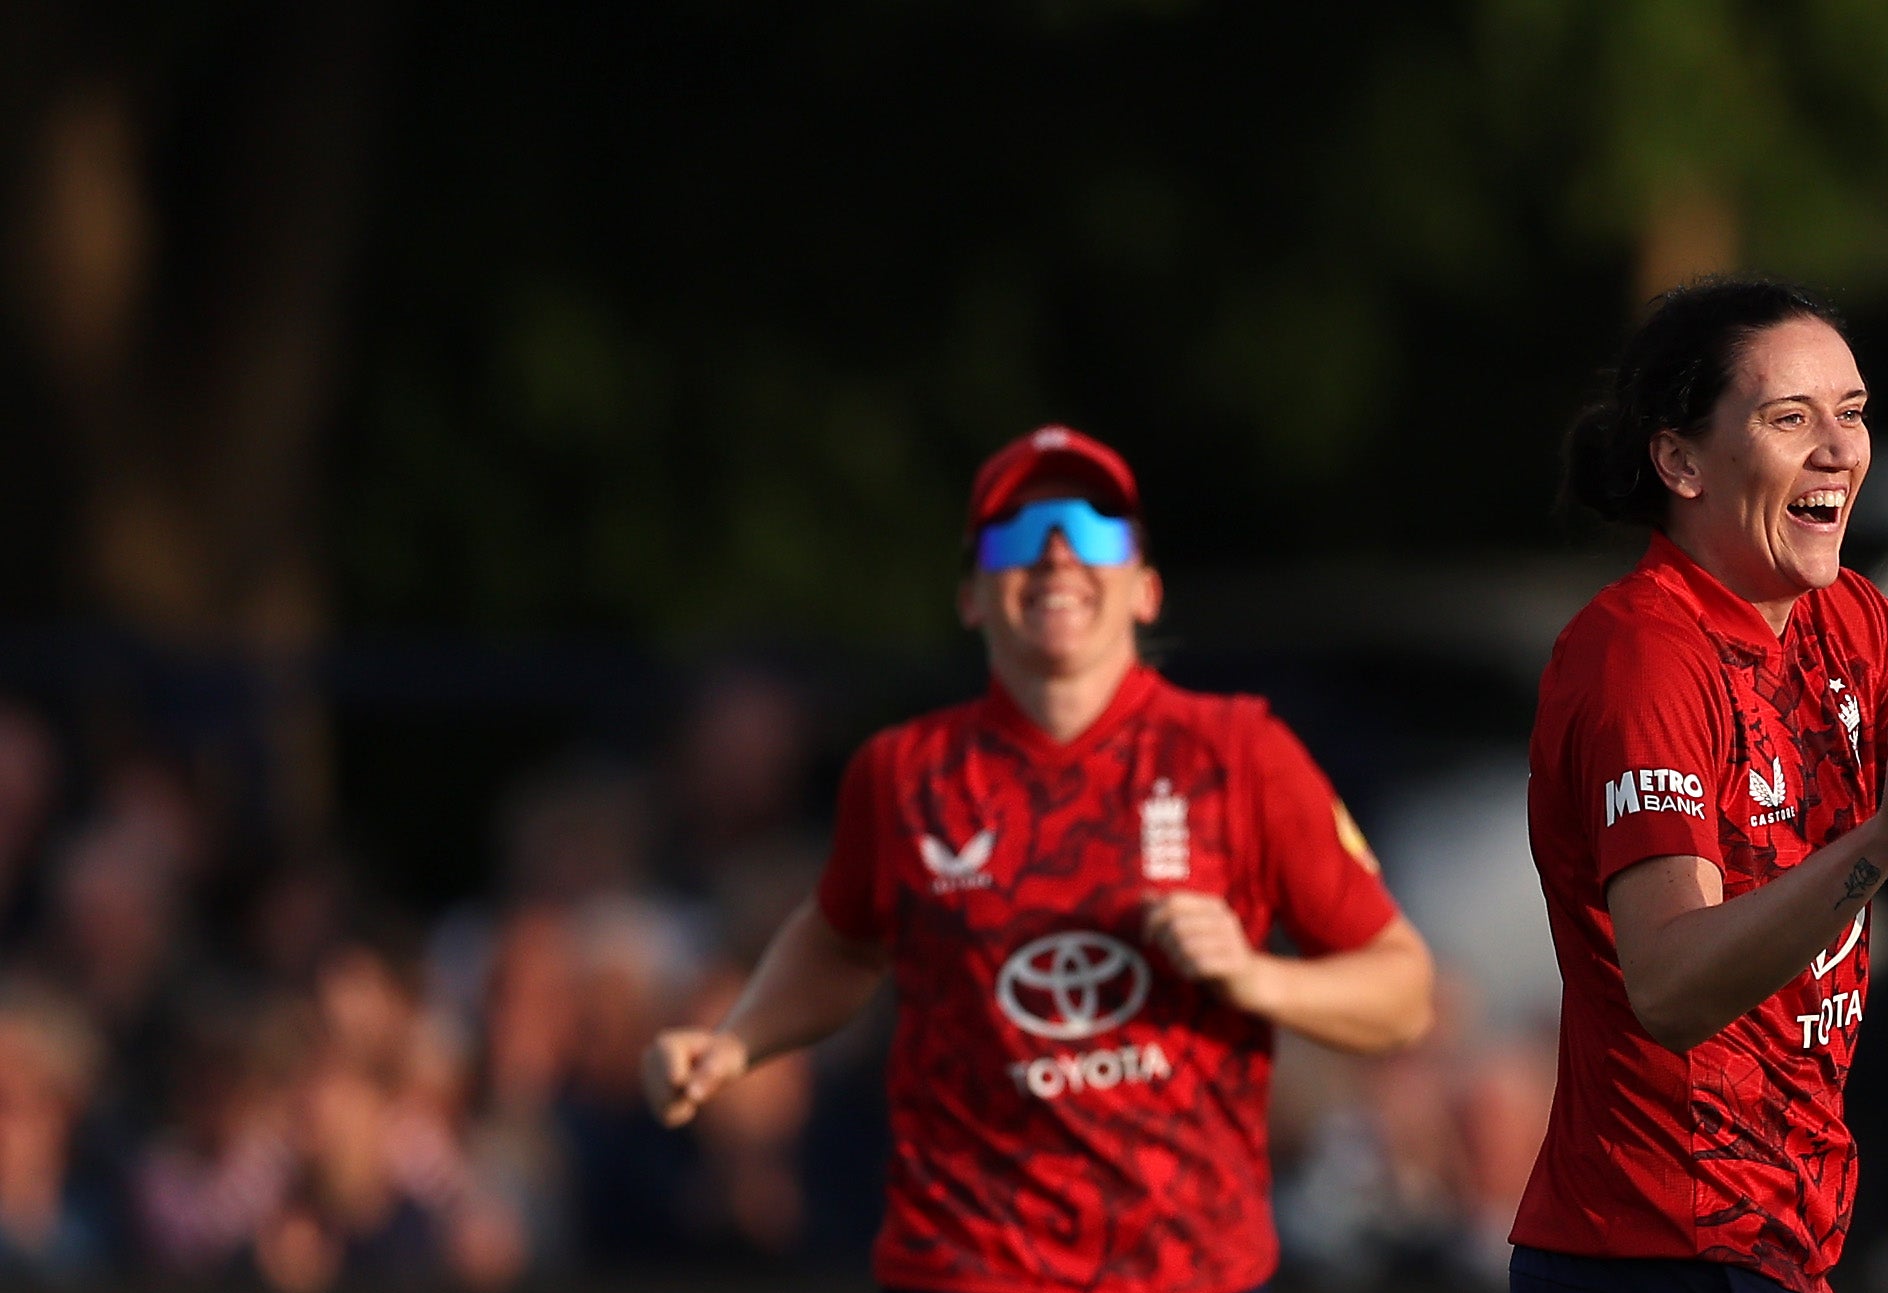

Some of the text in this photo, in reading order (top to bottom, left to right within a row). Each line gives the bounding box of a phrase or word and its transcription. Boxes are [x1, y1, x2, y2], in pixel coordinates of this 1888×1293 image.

[1605, 768, 1704, 828] METRO
[1644, 795, 1706, 820] BANK
[1750, 806, 1796, 828] CASTORE
[1008, 1044, 1172, 1099] TOYOTA
